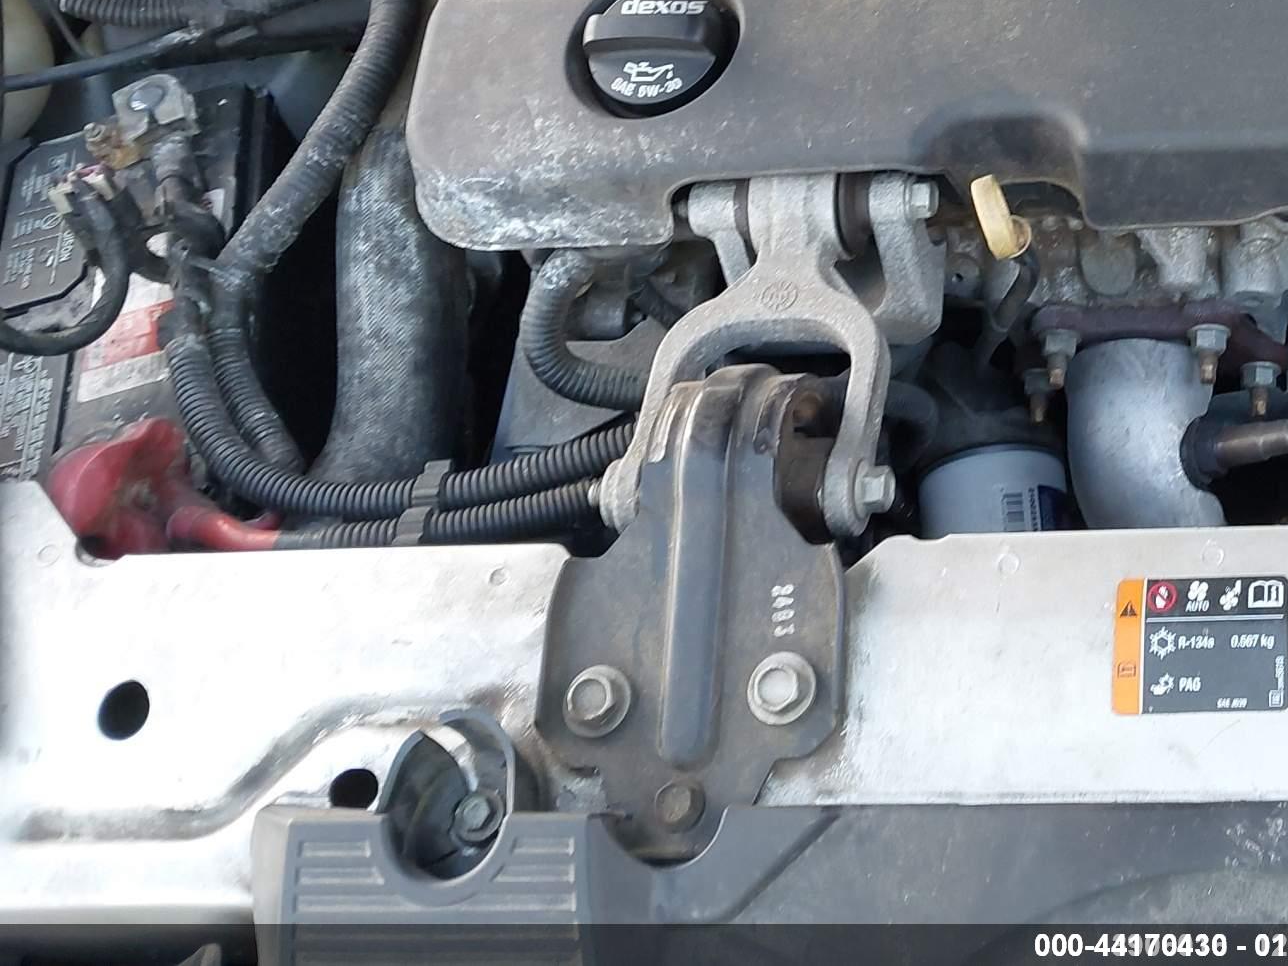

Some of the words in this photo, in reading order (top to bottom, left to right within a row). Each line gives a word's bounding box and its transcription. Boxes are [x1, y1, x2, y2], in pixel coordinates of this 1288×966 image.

[1185, 600, 1210, 612] AUTO
[1260, 634, 1275, 650] kg
[1178, 676, 1202, 692] PAG
